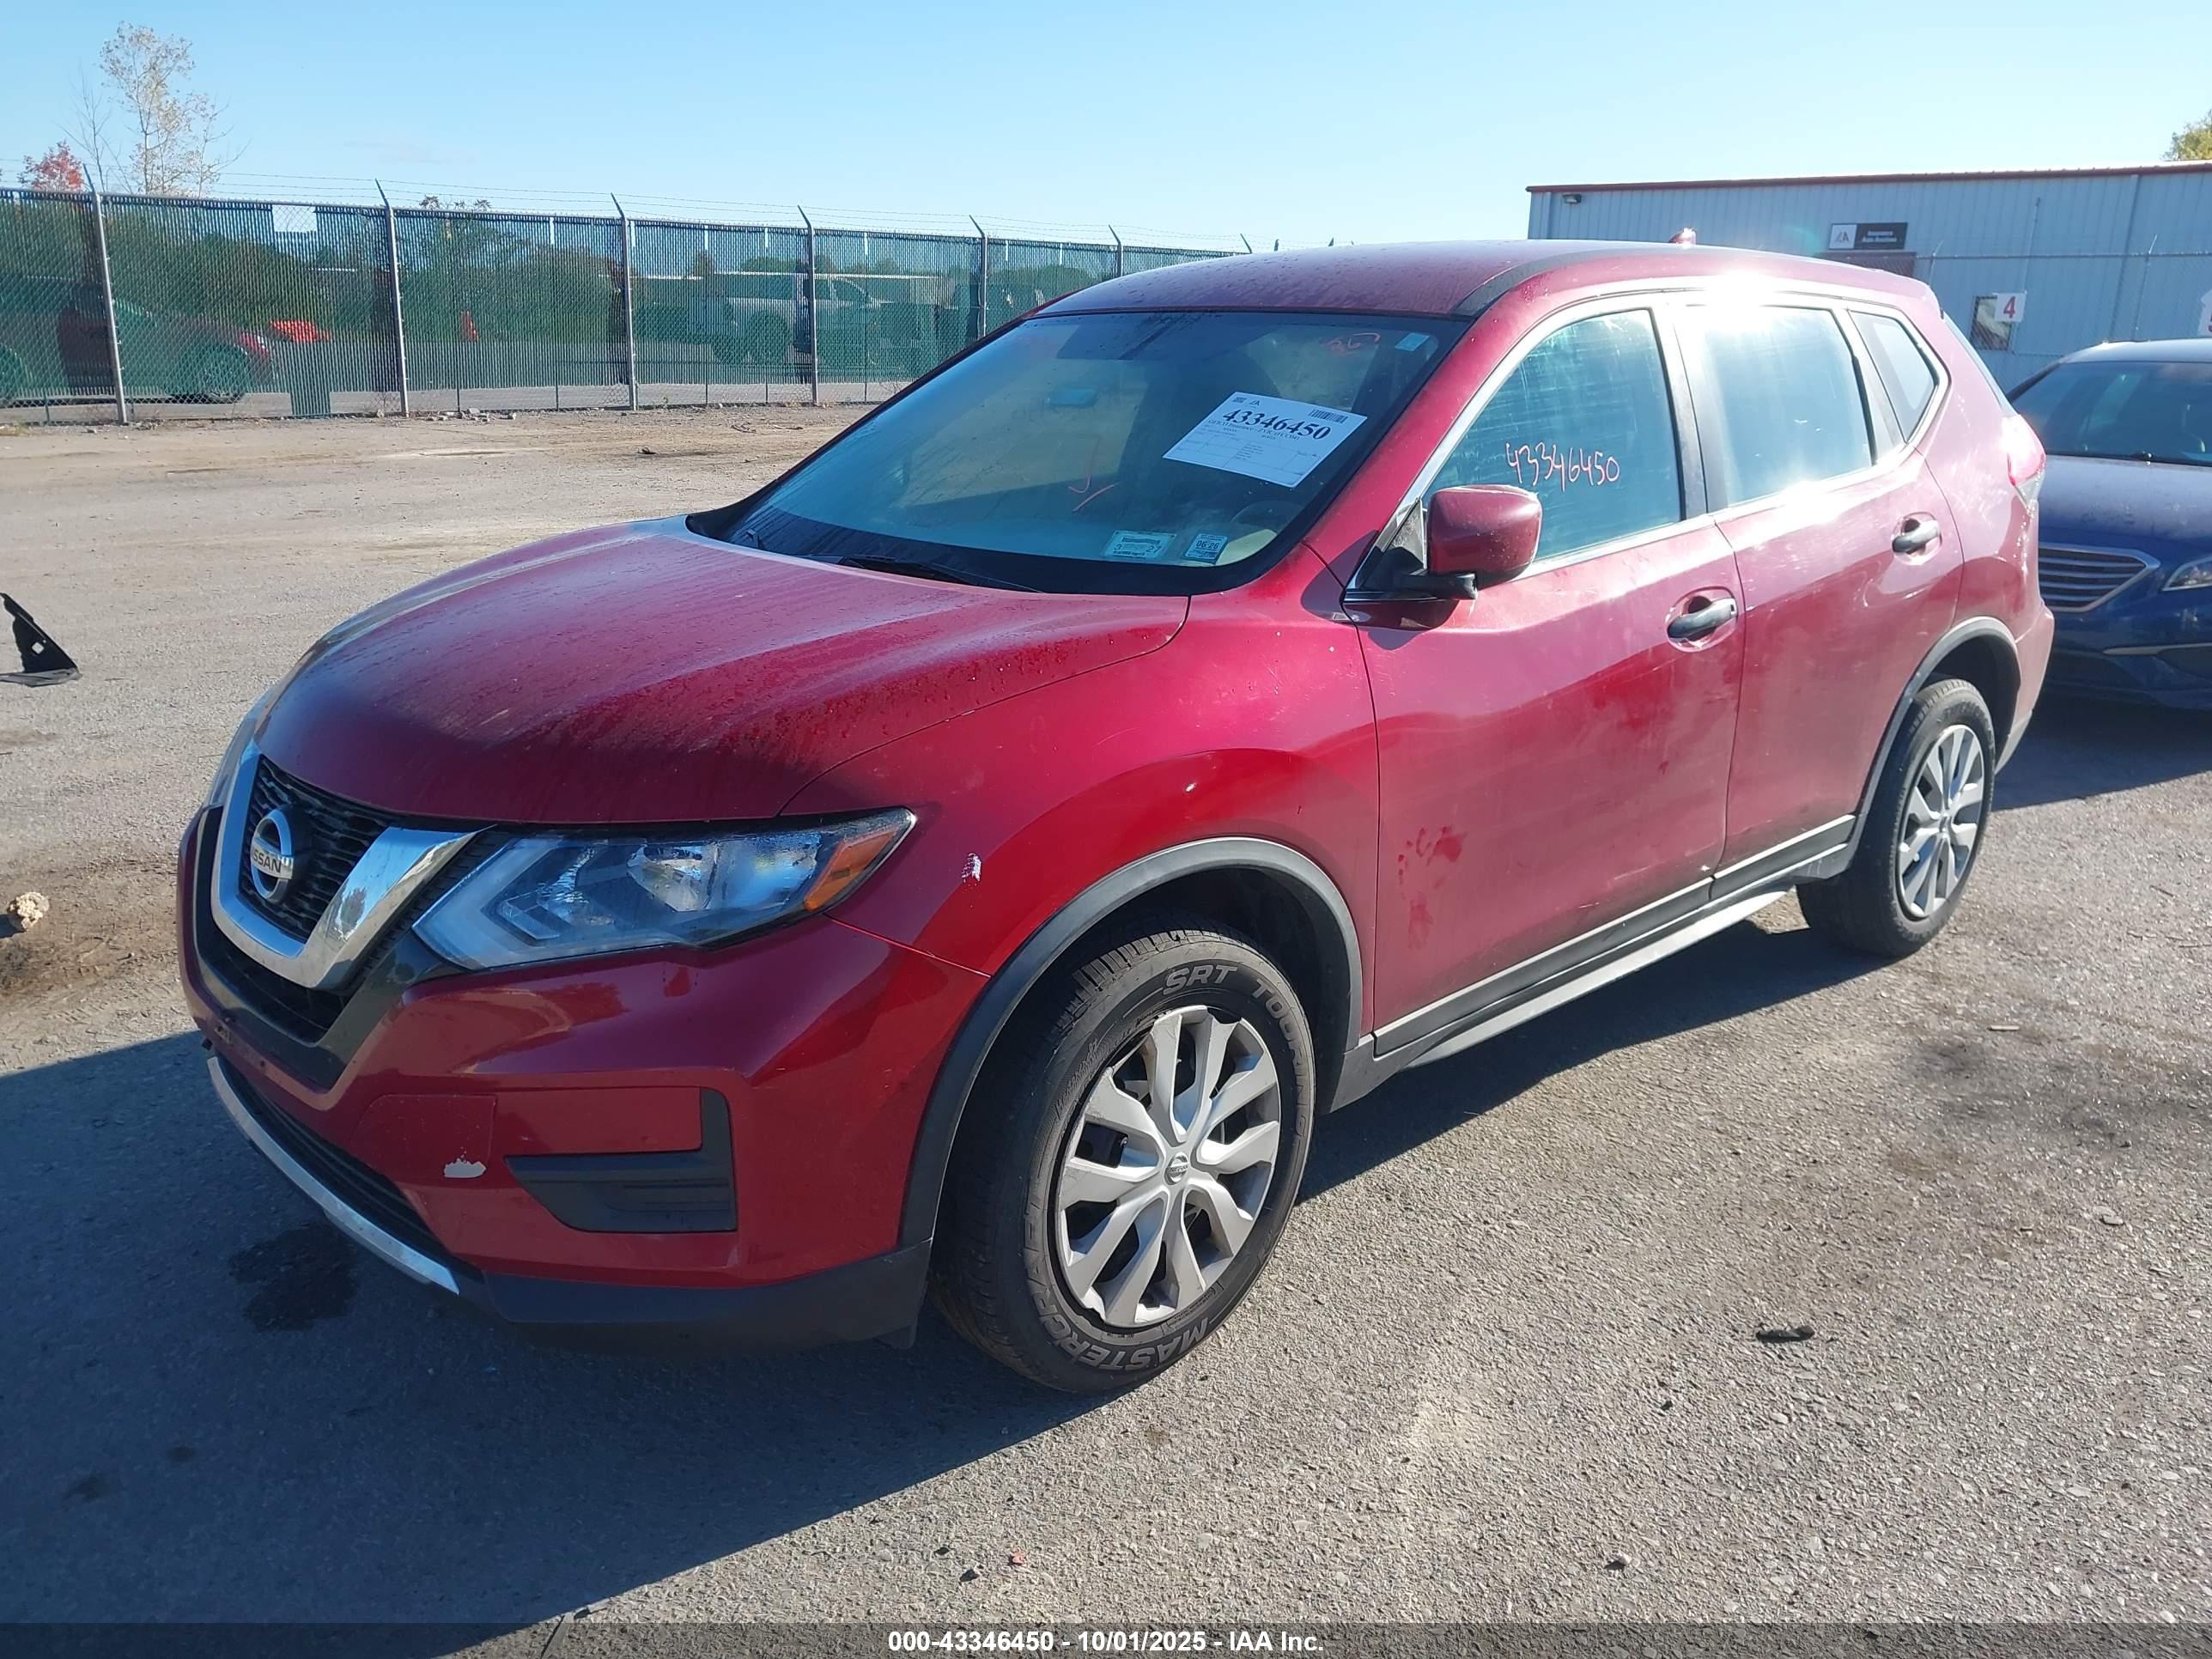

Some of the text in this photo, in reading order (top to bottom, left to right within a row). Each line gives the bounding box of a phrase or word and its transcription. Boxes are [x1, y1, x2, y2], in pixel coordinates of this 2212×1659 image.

[2002, 295, 2015, 318] 4
[1223, 408, 1331, 440] 43346450
[1505, 441, 1620, 492] 43346450
[1163, 965, 1237, 995] SRT
